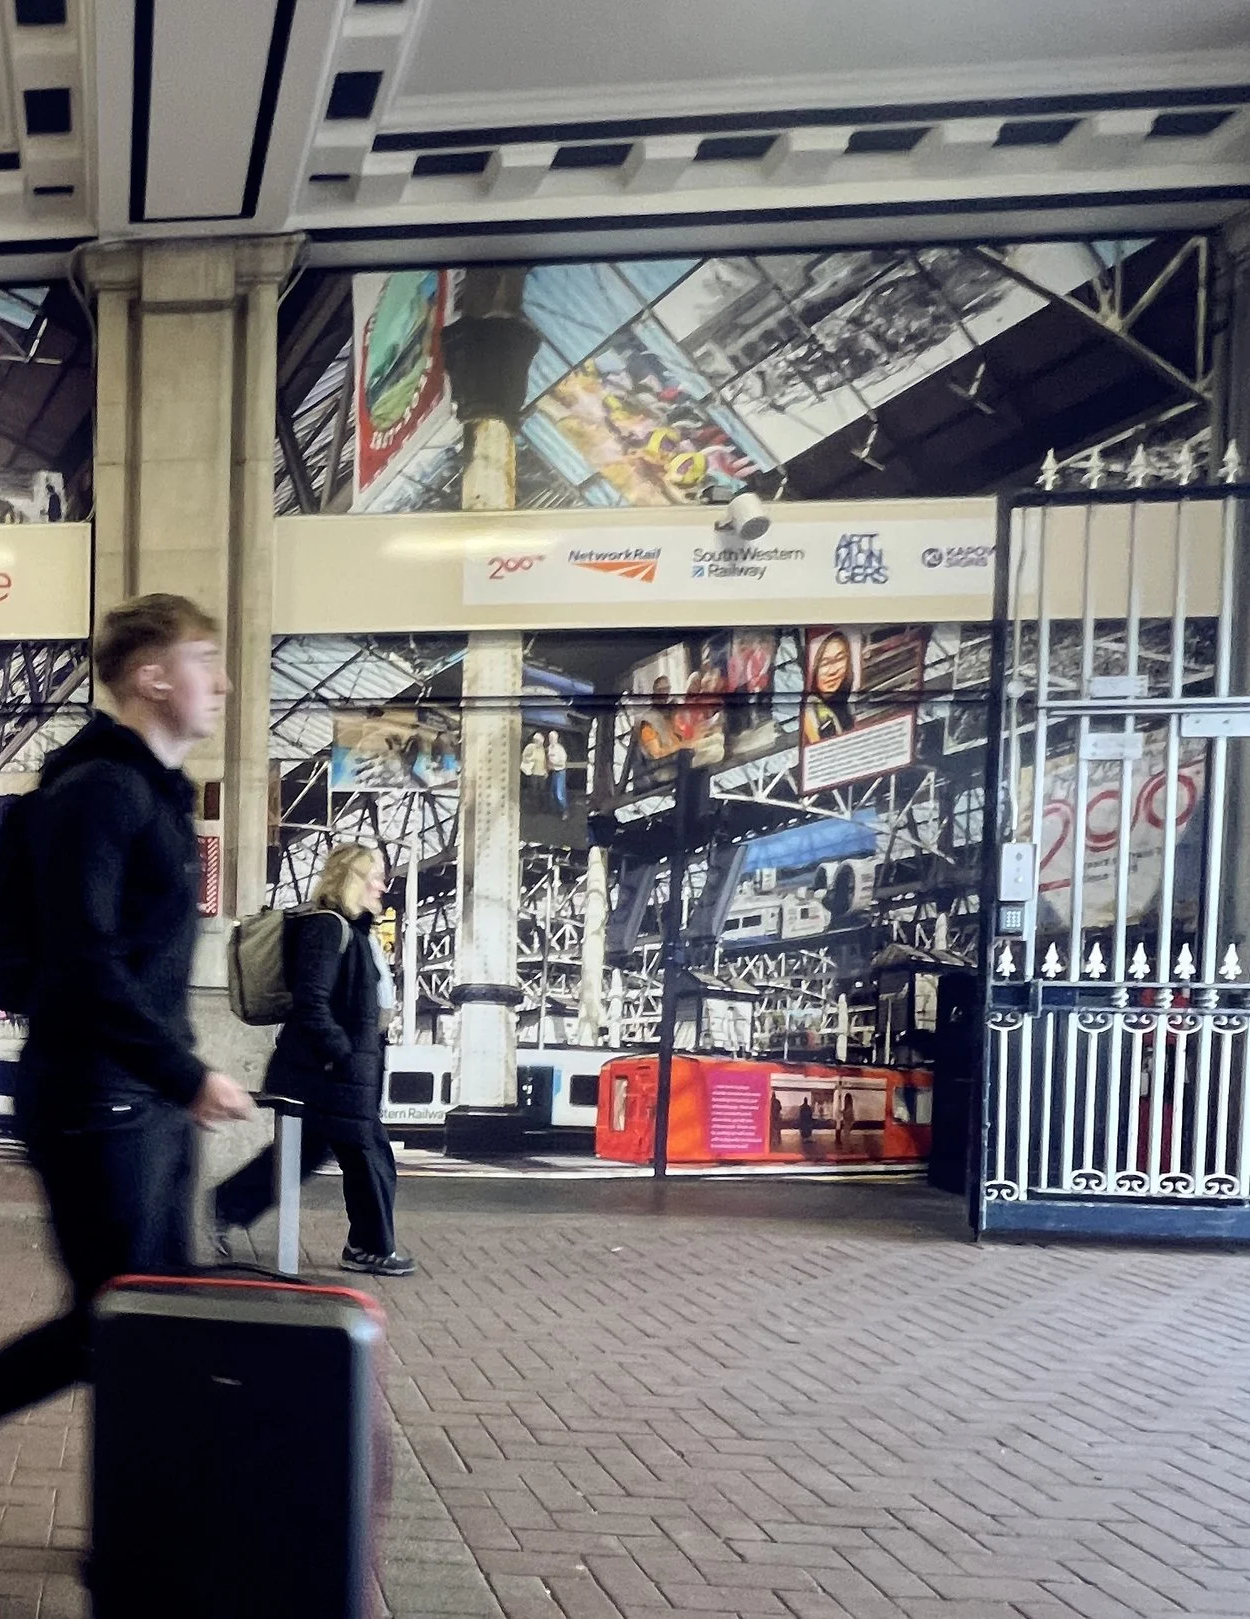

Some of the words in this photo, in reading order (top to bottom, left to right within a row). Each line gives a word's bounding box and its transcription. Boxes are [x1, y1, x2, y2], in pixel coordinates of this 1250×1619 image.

[692, 547, 738, 563] South
[739, 547, 806, 561] Western
[708, 563, 767, 581] Railway
